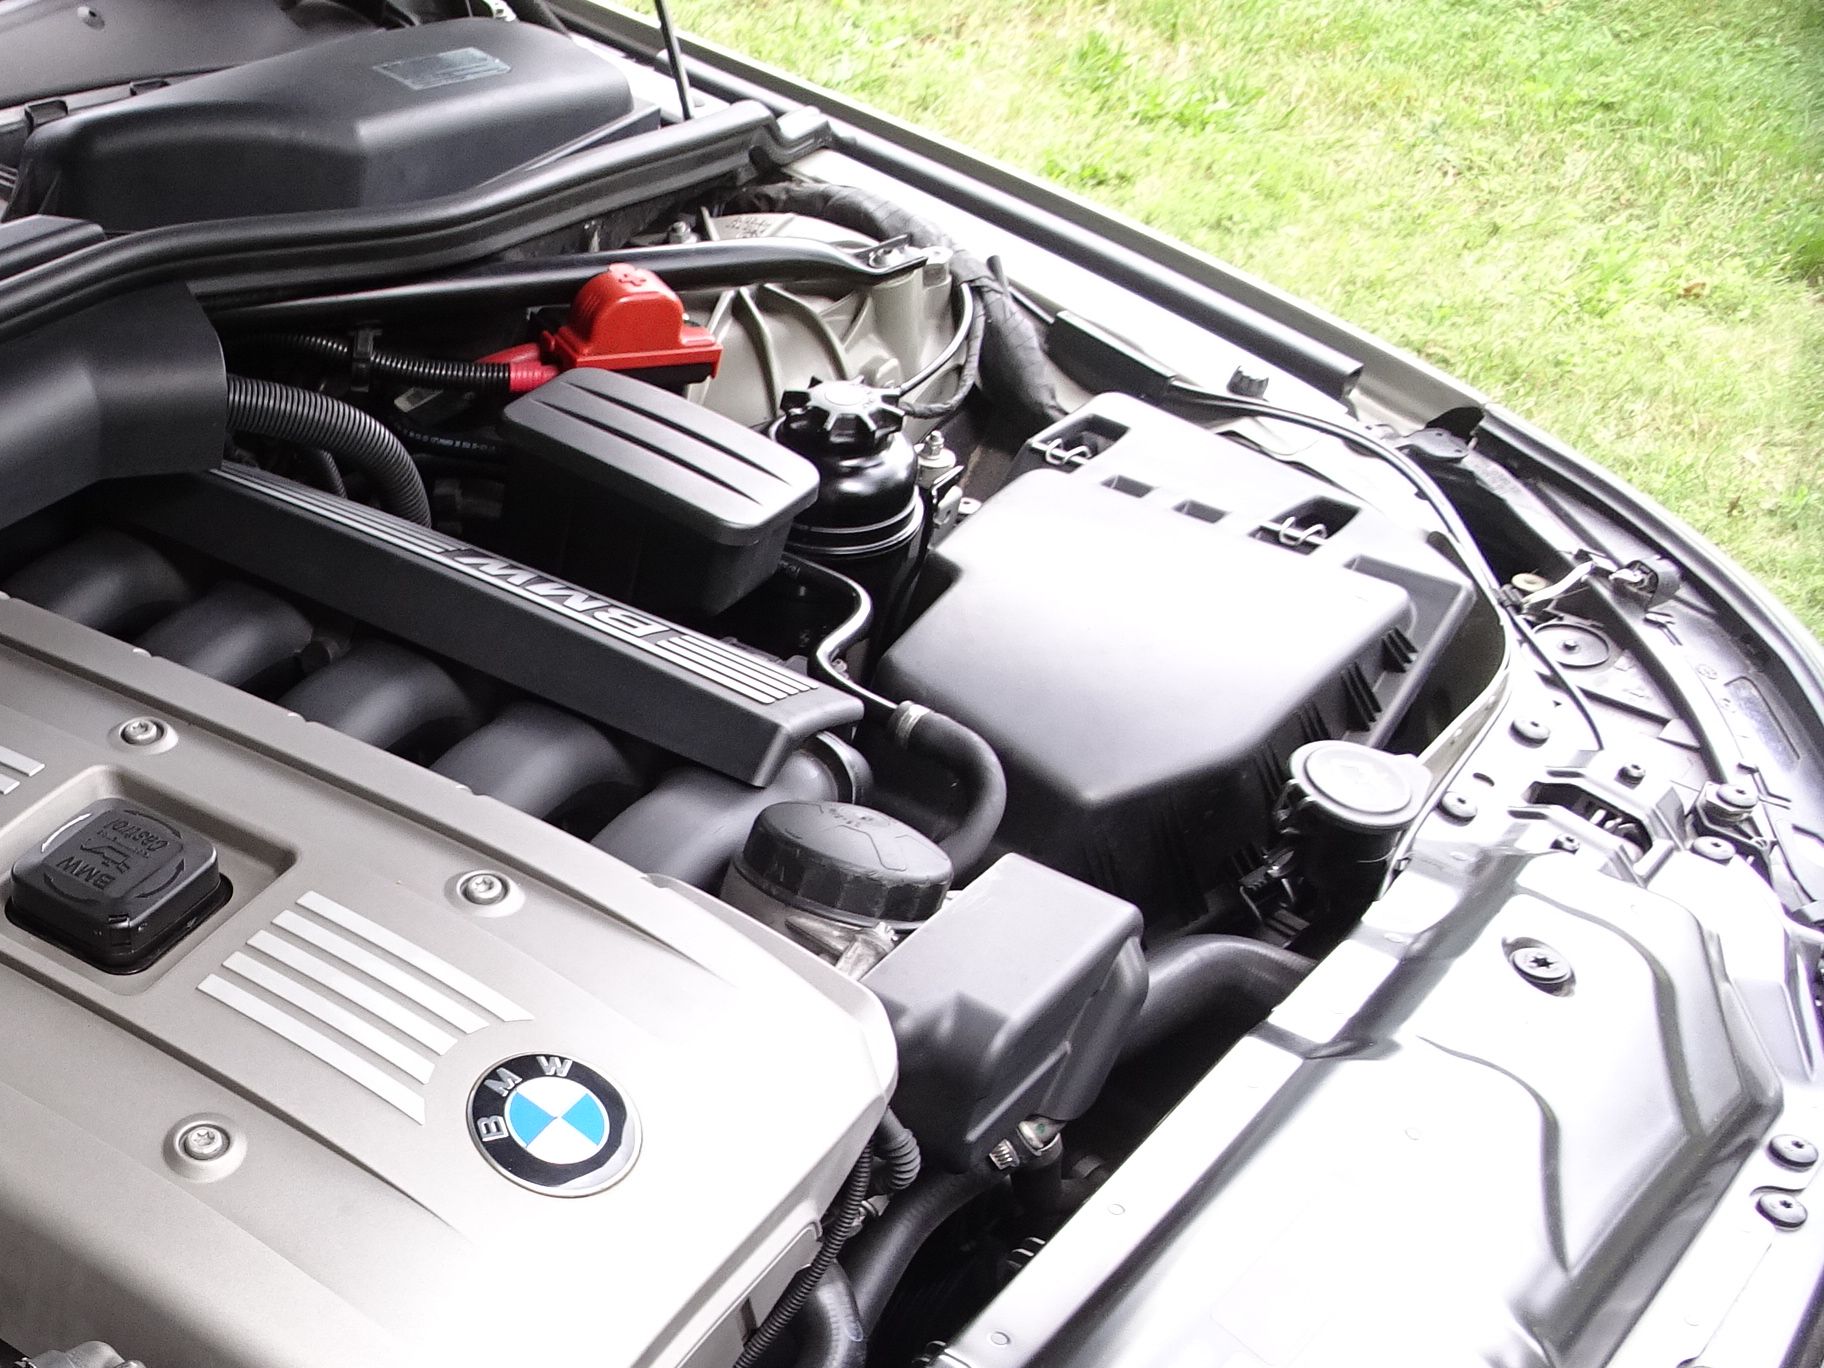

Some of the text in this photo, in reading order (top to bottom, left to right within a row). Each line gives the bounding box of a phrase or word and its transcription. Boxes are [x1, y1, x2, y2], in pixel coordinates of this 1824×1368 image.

[454, 556, 670, 637] BMW
[102, 819, 169, 852] Castrol
[56, 856, 116, 890] BMW
[476, 1055, 573, 1142] BMW
